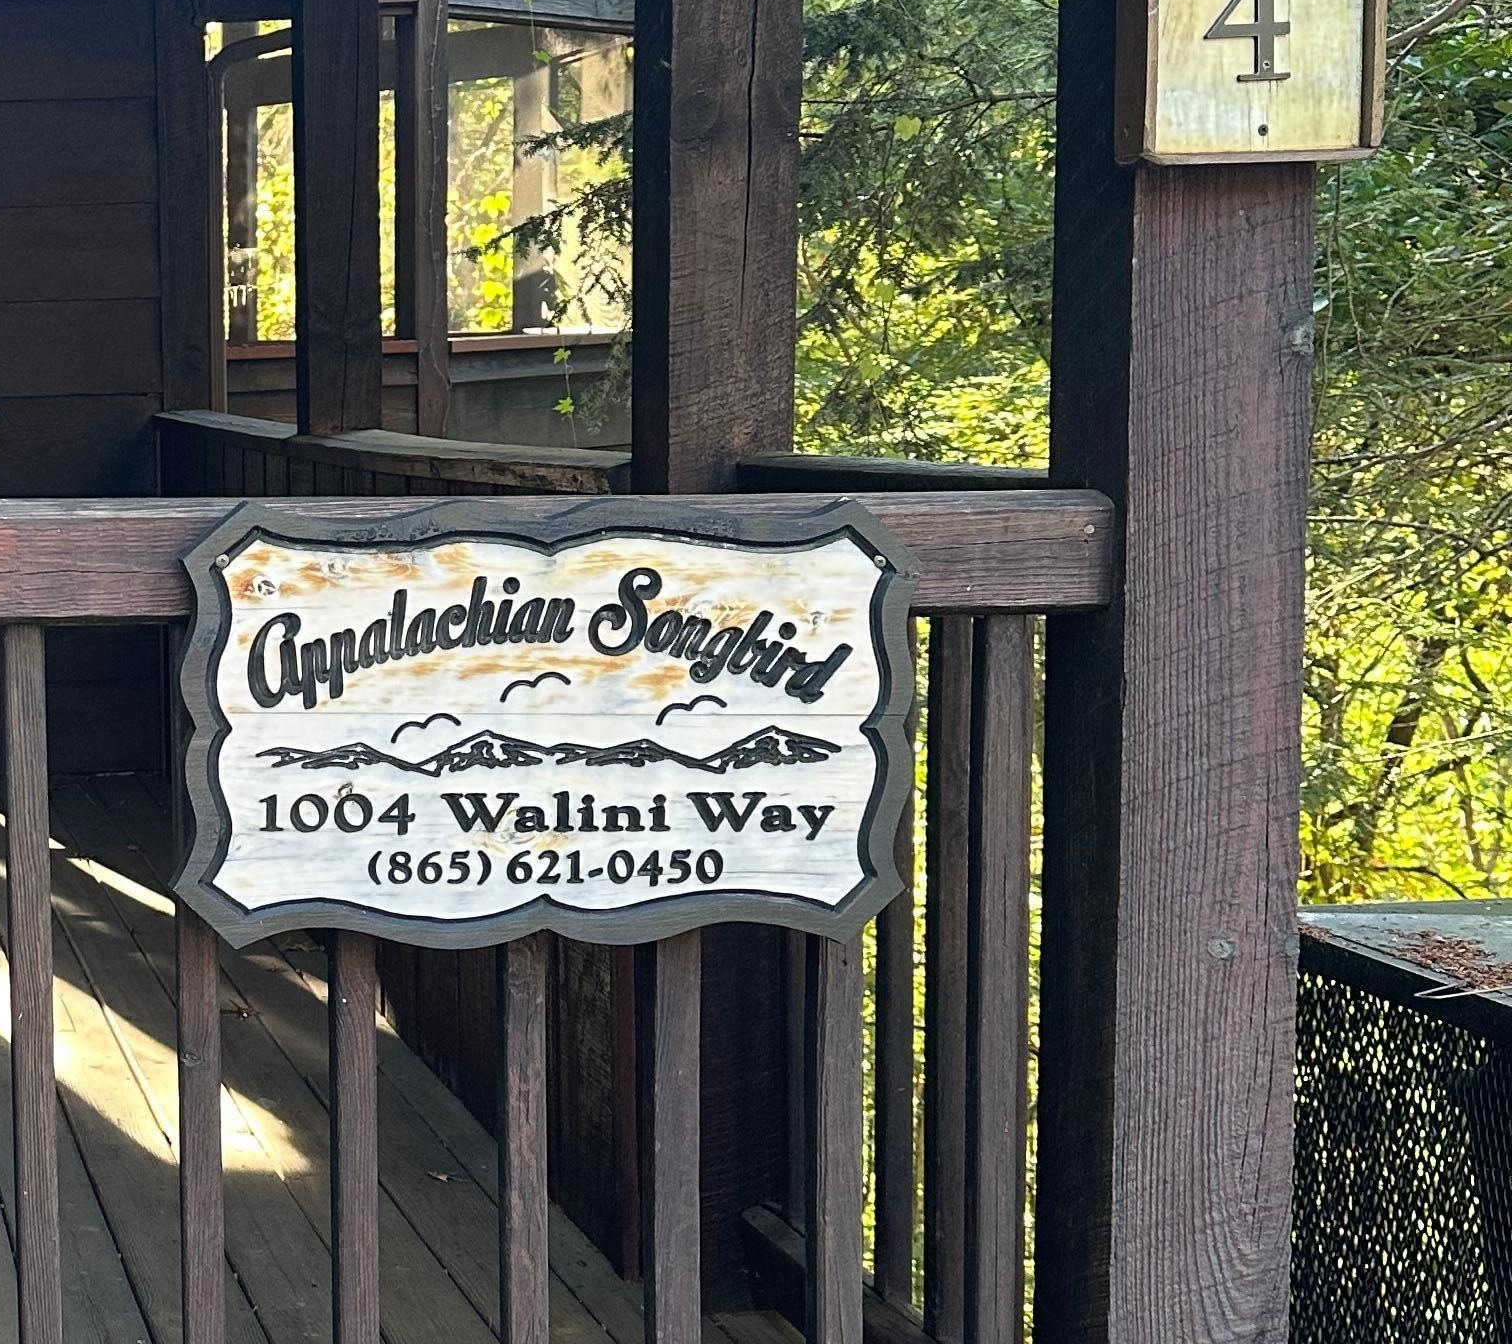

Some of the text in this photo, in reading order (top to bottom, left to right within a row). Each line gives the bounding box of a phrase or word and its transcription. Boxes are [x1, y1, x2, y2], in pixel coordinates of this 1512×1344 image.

[248, 567, 853, 709] Appalachian Songbird
[258, 792, 835, 839] 1004 Walini Way
[367, 851, 724, 885] (865) 621-0450
